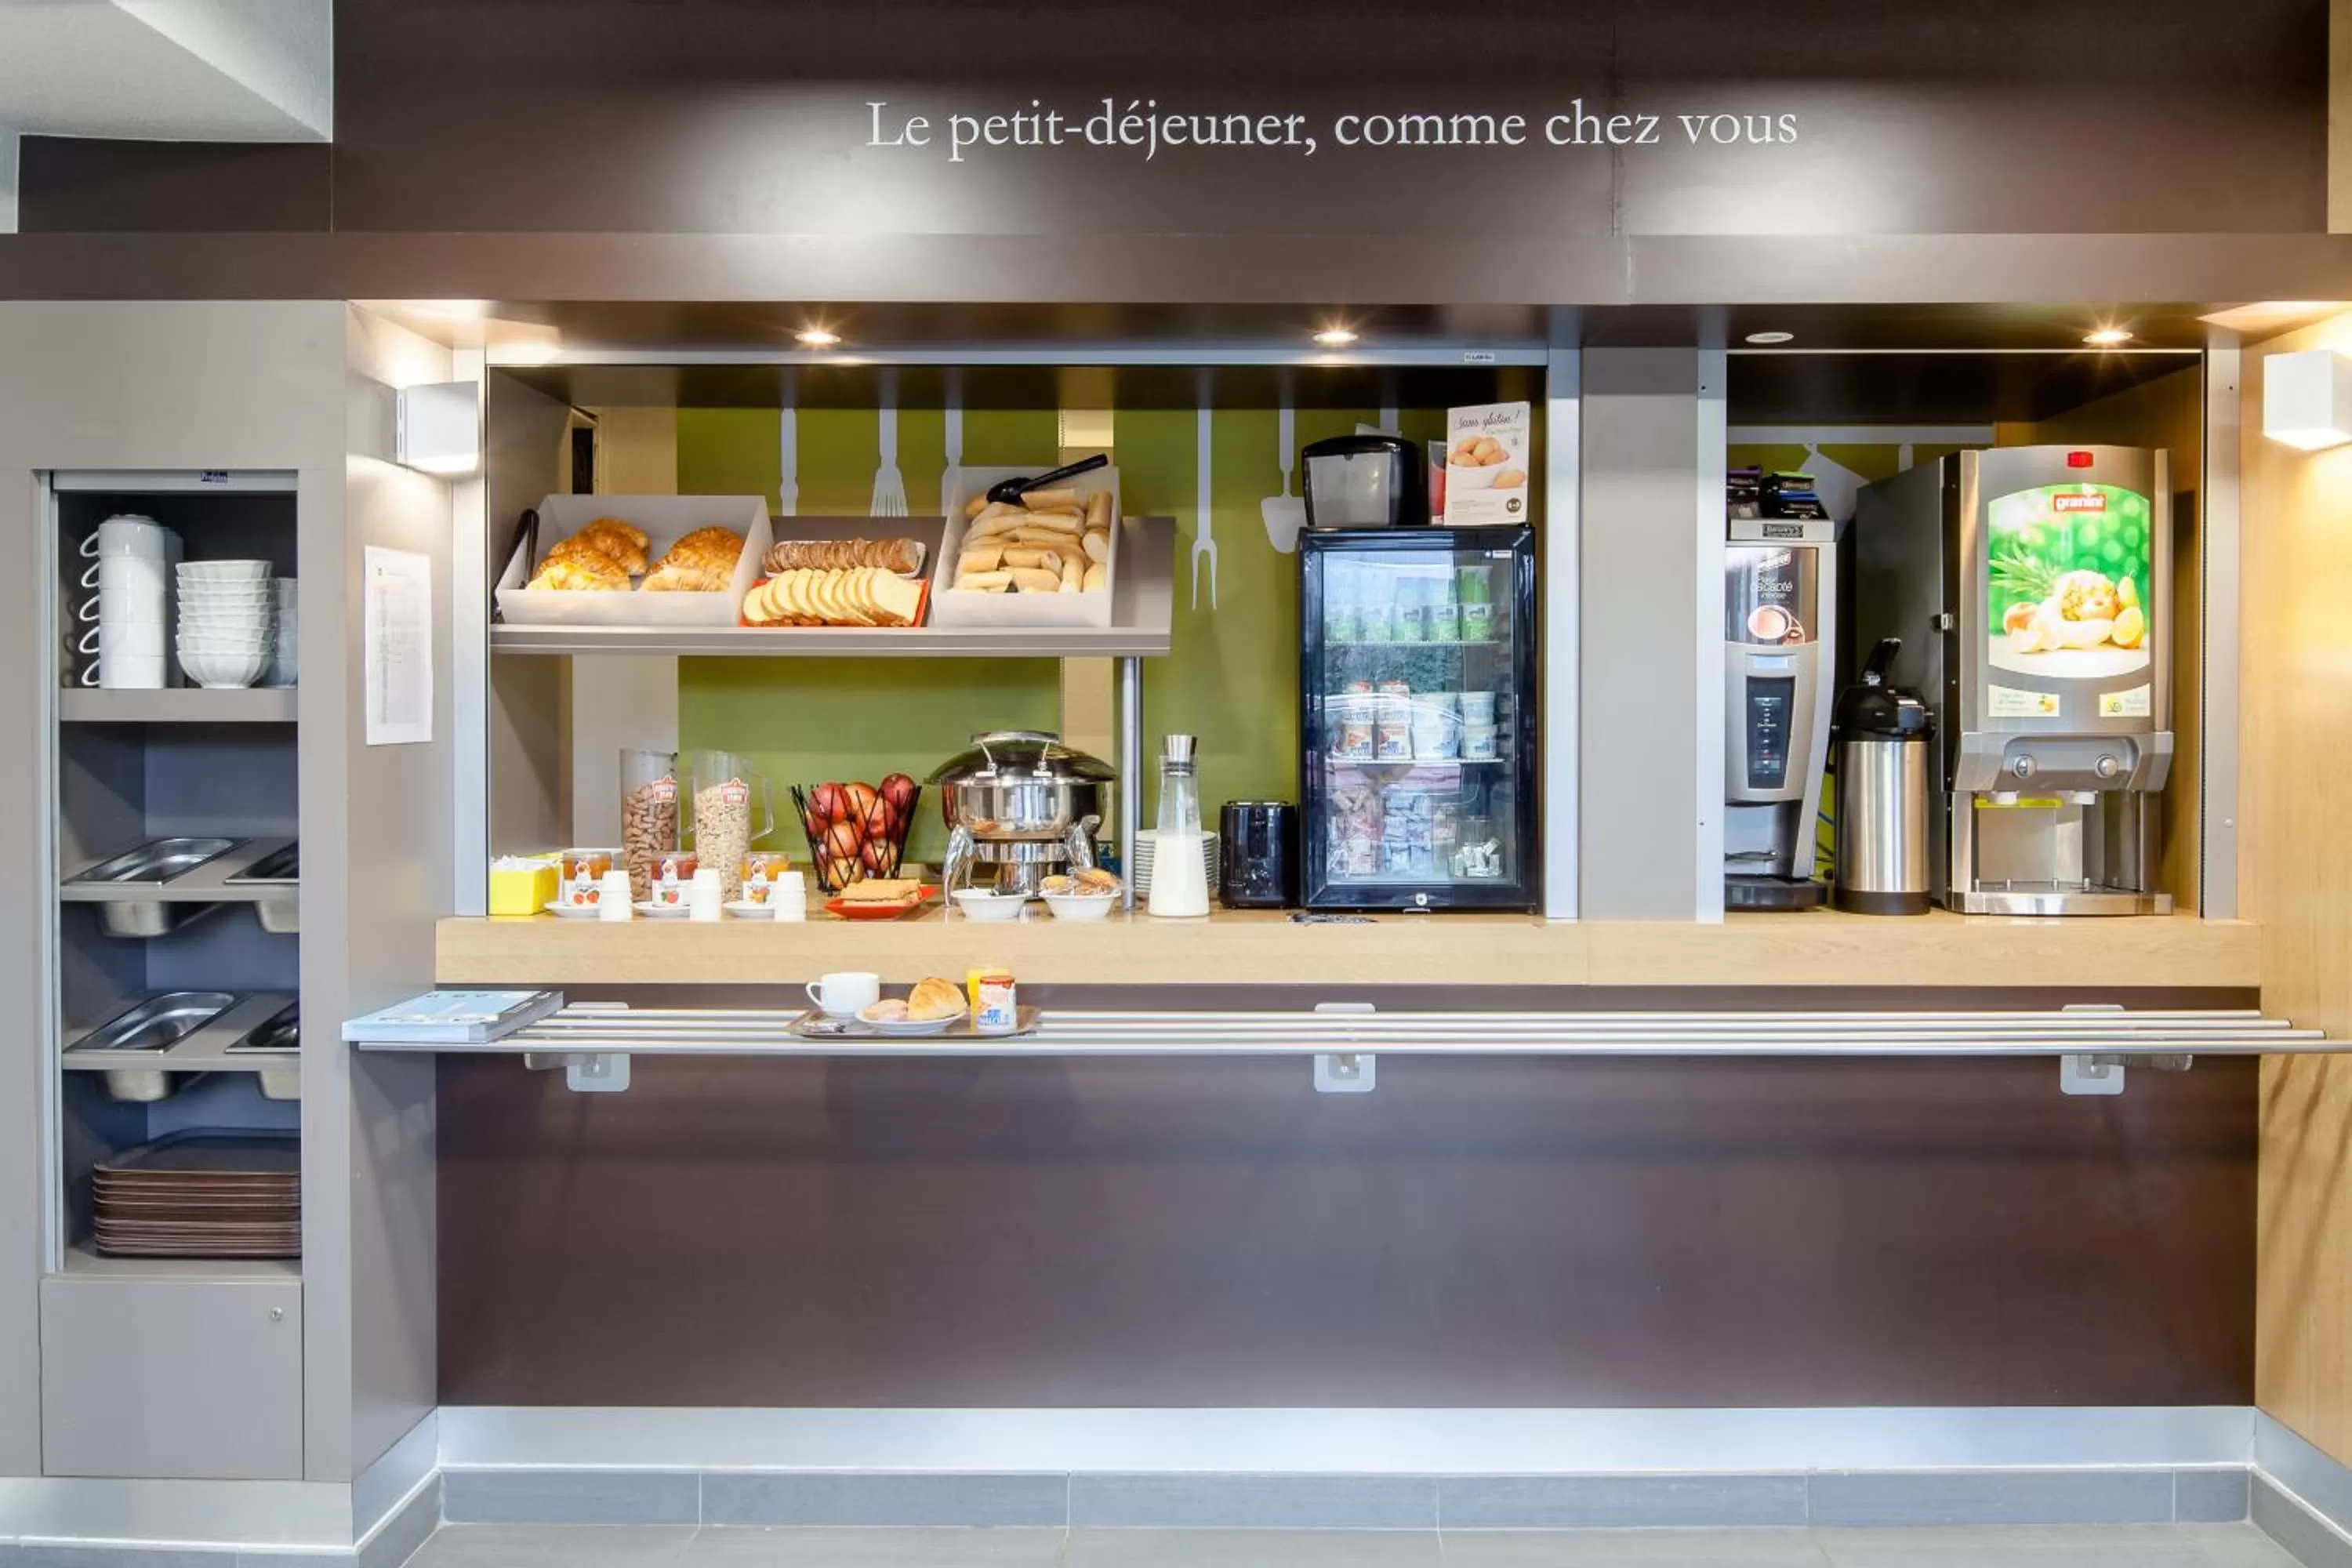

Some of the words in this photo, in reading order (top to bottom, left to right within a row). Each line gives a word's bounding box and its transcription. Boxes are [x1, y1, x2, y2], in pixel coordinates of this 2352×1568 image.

[866, 101, 931, 147] Le
[947, 96, 1318, 163] petit-déjeuner,
[1334, 113, 1527, 147] comme
[1544, 97, 1661, 147] chez
[1676, 113, 1798, 144] vous
[1482, 412, 1511, 430] gluten
[2056, 494, 2105, 511] granini
